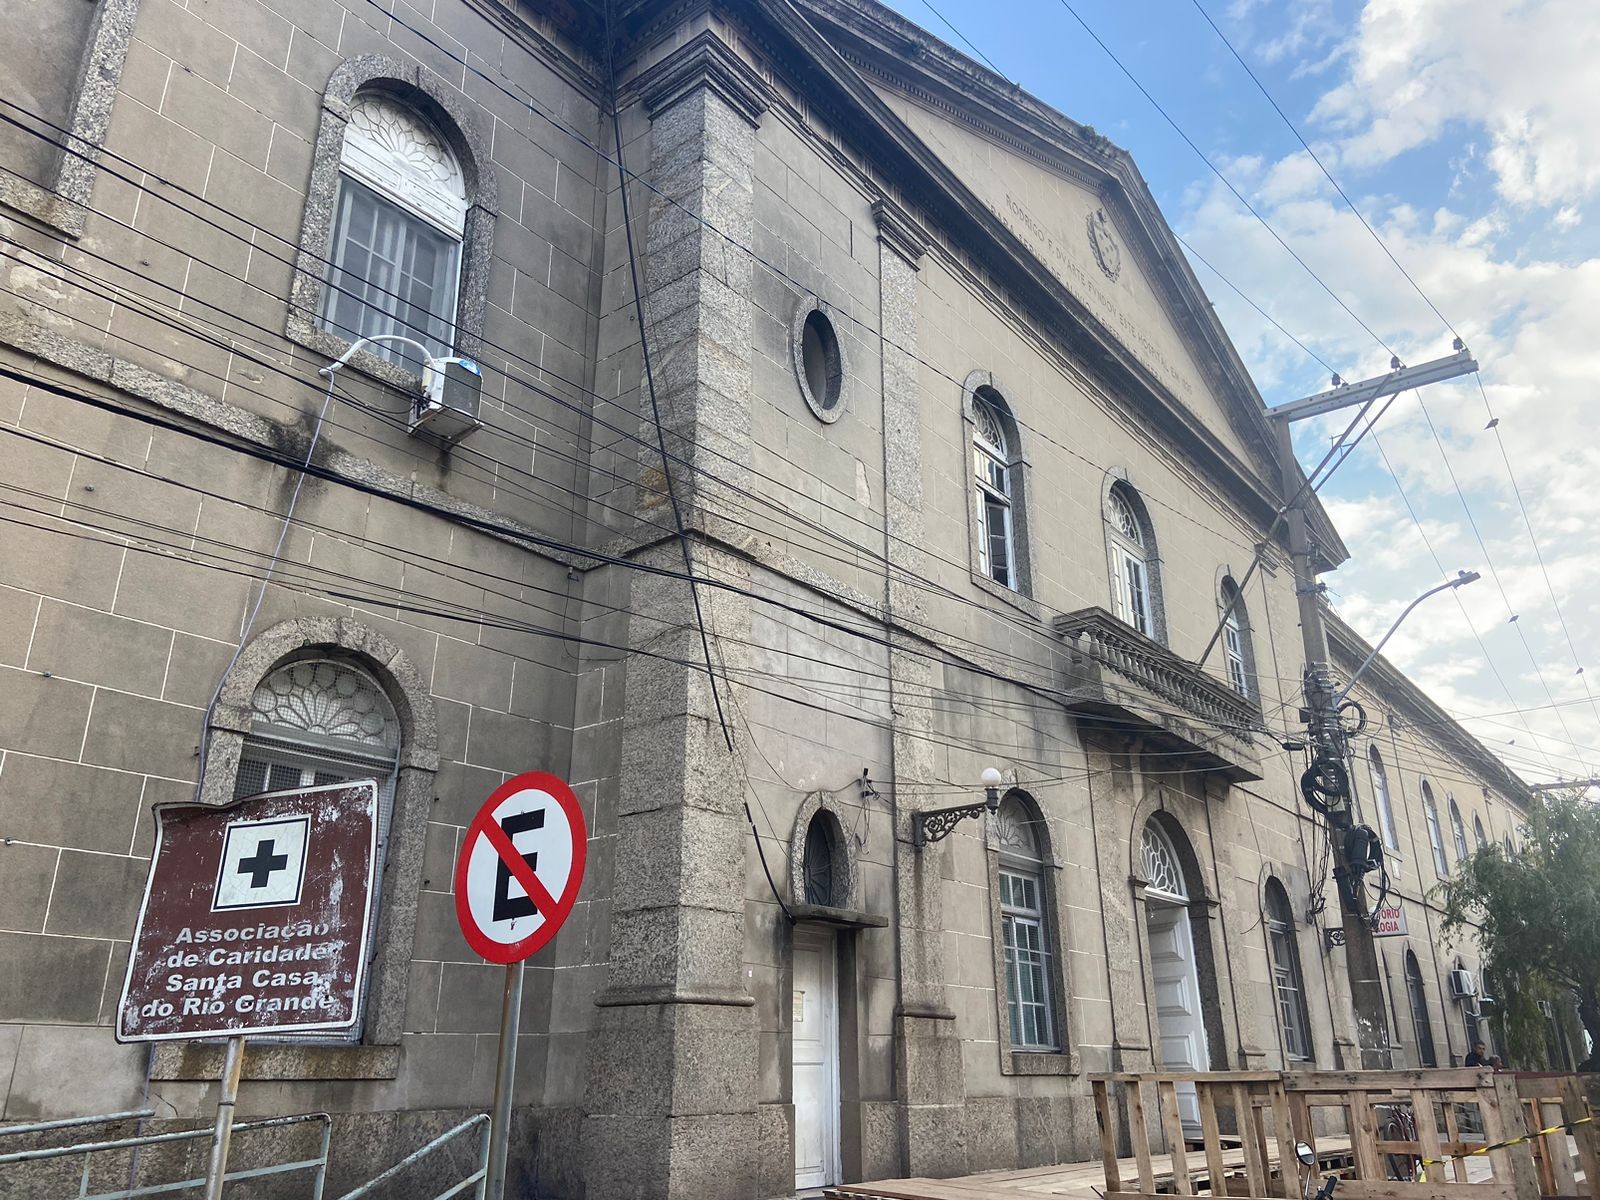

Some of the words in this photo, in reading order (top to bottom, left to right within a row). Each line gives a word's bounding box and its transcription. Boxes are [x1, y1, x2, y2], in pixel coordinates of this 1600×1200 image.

[1005, 193, 1045, 242] RODRIGO
[493, 808, 545, 922] E
[175, 920, 329, 944] Associação
[167, 951, 199, 969] de
[208, 943, 328, 967] Caridade
[165, 973, 242, 993] Santa
[252, 969, 319, 988] Casa
[141, 999, 174, 1017] do
[183, 997, 225, 1016] Rio
[235, 994, 334, 1014] Grande
